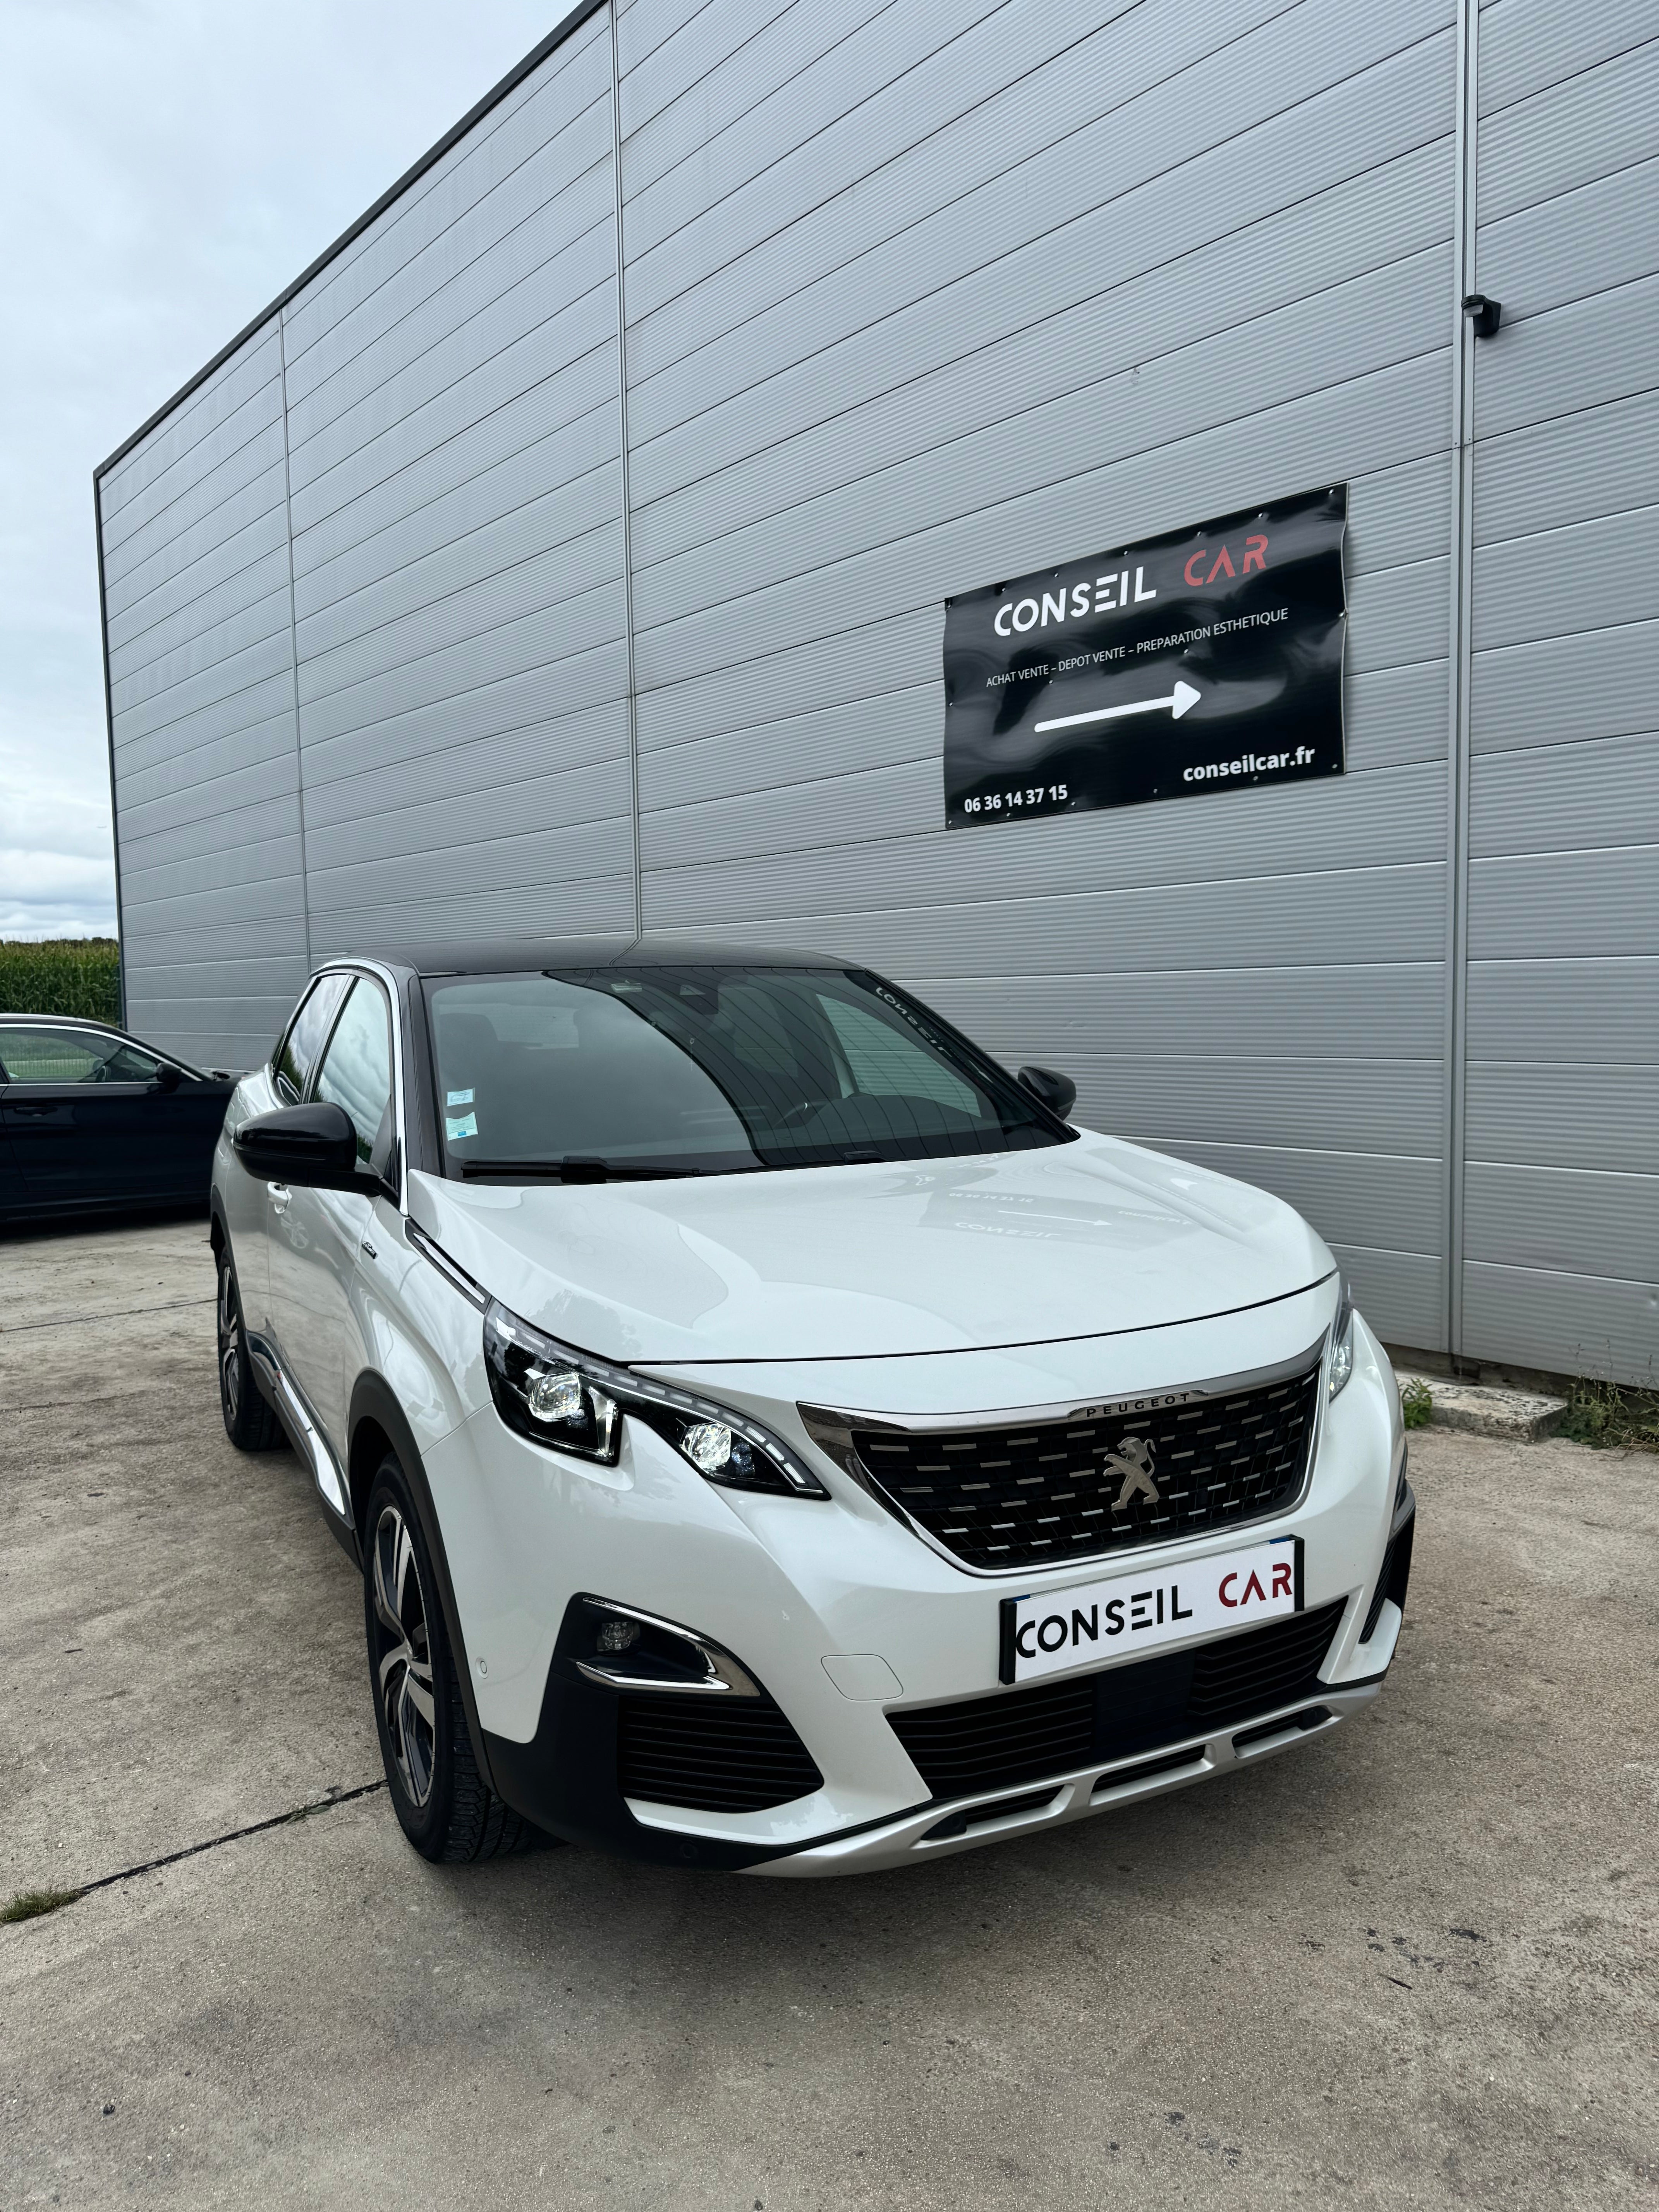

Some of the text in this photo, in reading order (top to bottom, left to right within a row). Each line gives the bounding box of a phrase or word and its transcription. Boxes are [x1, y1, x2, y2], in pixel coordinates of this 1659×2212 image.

[994, 534, 1269, 636] CONSEIL CAR
[986, 672, 1017, 687] ACHAT
[1018, 665, 1049, 680] VENTE
[1059, 654, 1091, 672] DEPOT
[1092, 646, 1126, 663] VENTE
[1137, 626, 1211, 654] PREPARATION
[1213, 608, 1288, 635] ESTHETIQUE
[1183, 745, 1315, 781] conseilcar.fr
[964, 784, 1068, 813] 06 36 14 37 15
[1086, 1393, 1190, 1417] PEUGEOT
[1015, 1562, 1293, 1659] CONSEIL CAR
